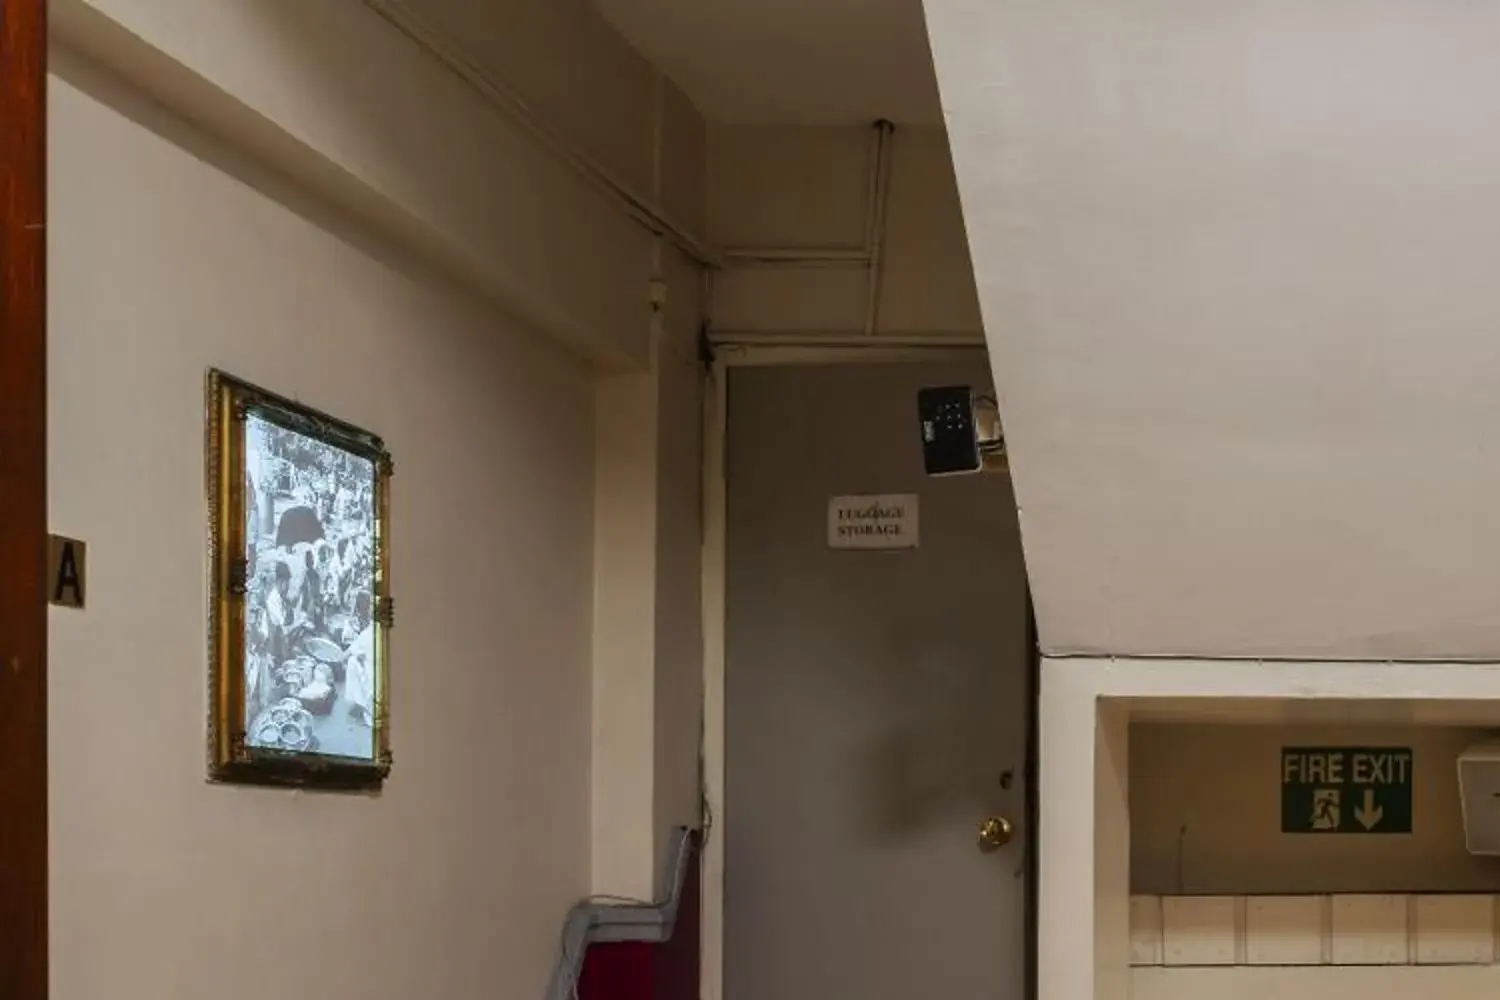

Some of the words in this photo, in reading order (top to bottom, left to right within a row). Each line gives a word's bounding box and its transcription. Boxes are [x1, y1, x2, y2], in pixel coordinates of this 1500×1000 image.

[838, 506, 904, 520] LUGGAGE
[838, 524, 901, 536] STORAGE
[56, 541, 83, 606] A
[1282, 753, 1344, 784] FIRE
[1352, 753, 1410, 784] EXIT
